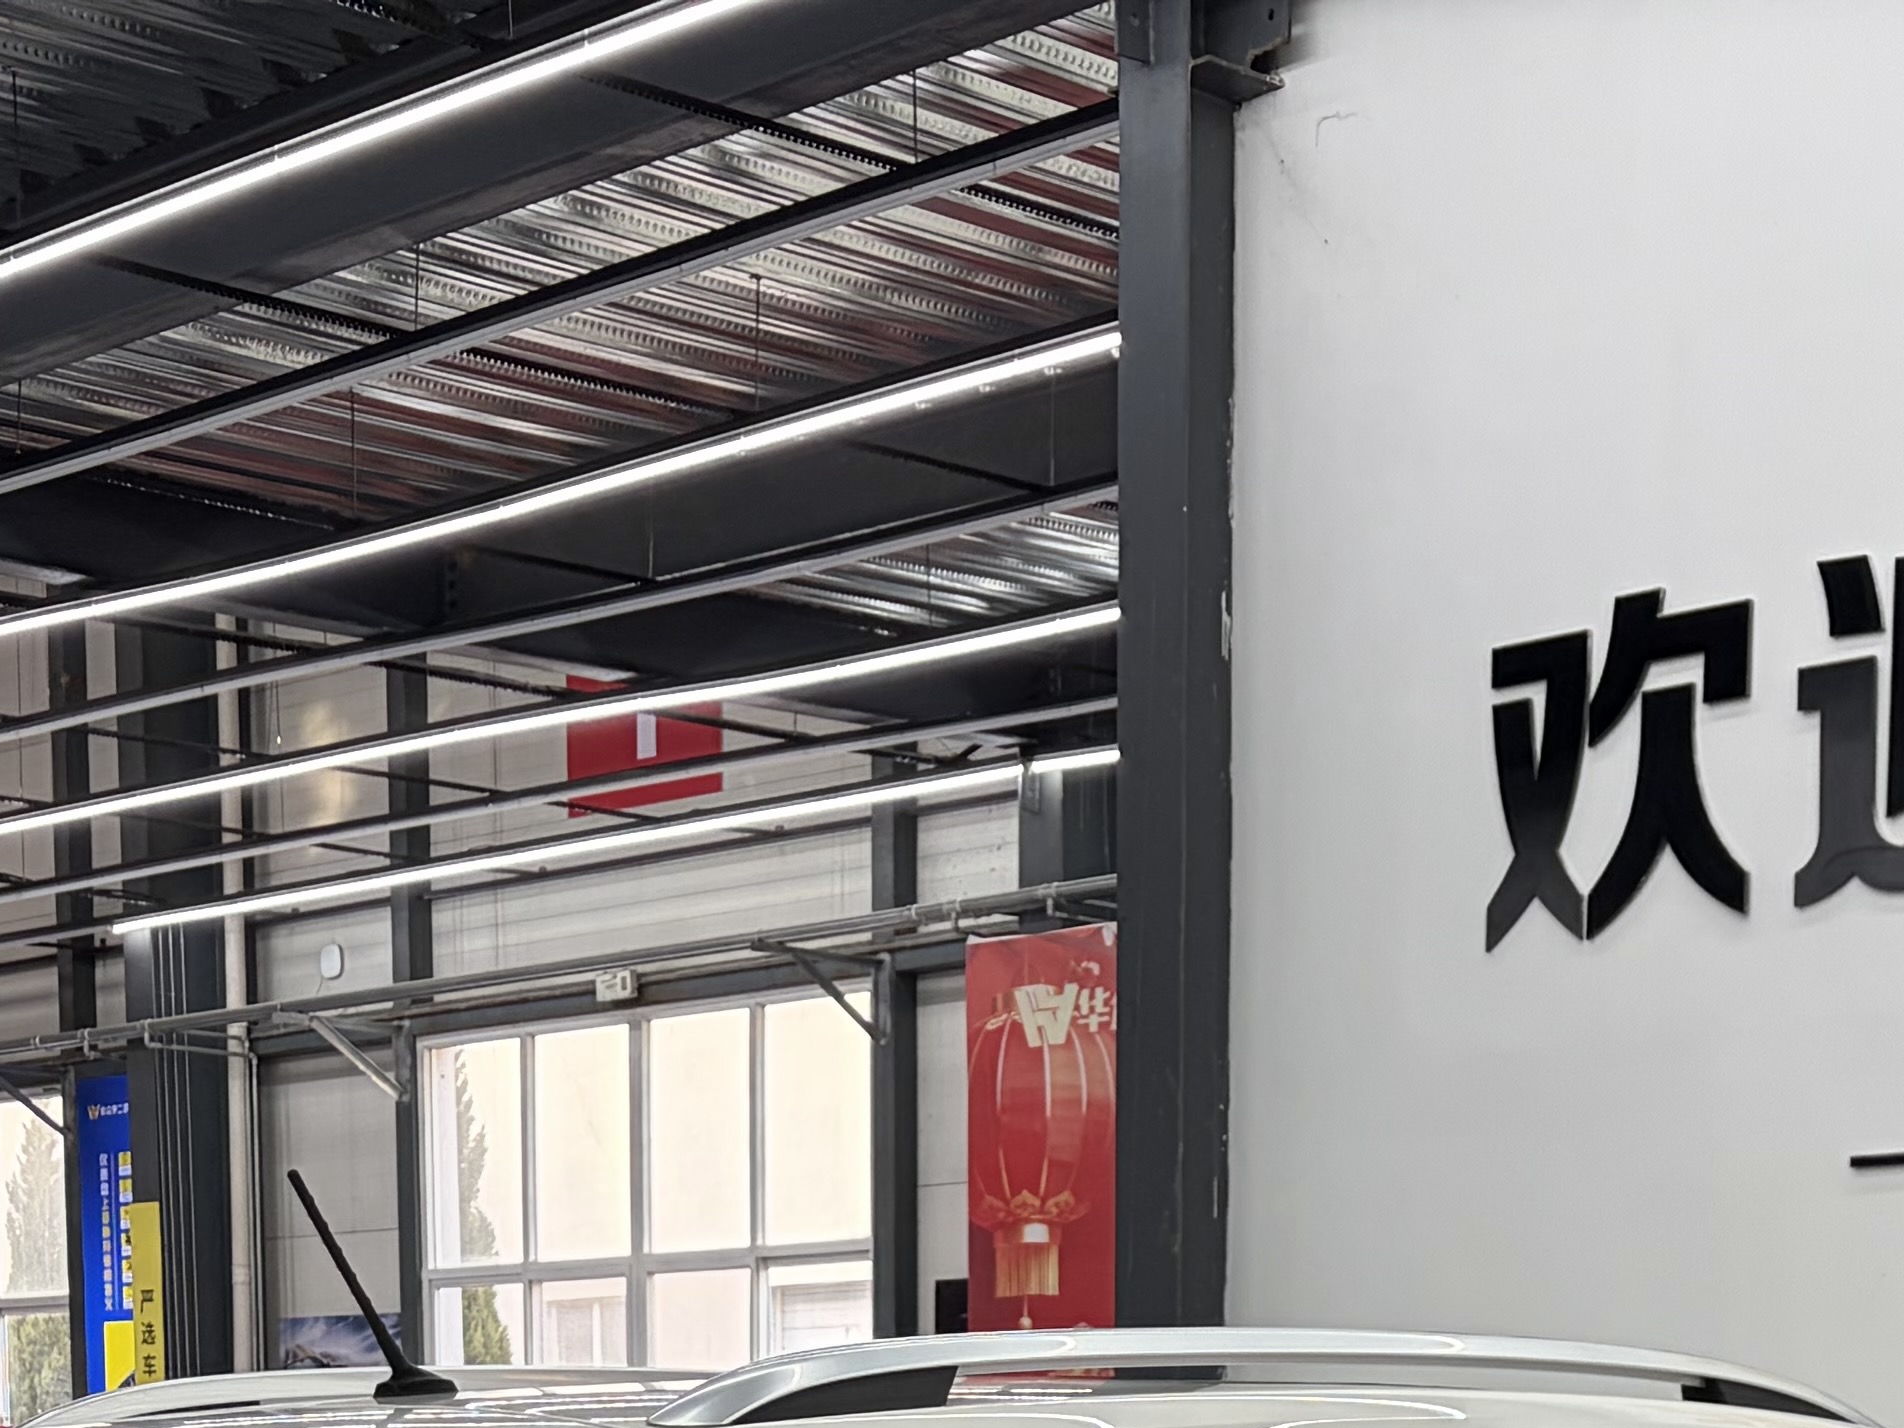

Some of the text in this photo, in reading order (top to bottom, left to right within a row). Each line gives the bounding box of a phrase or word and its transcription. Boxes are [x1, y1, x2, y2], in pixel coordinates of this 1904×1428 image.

[1077, 985, 1117, 1033] 华
[140, 1289, 157, 1377] 严选车
